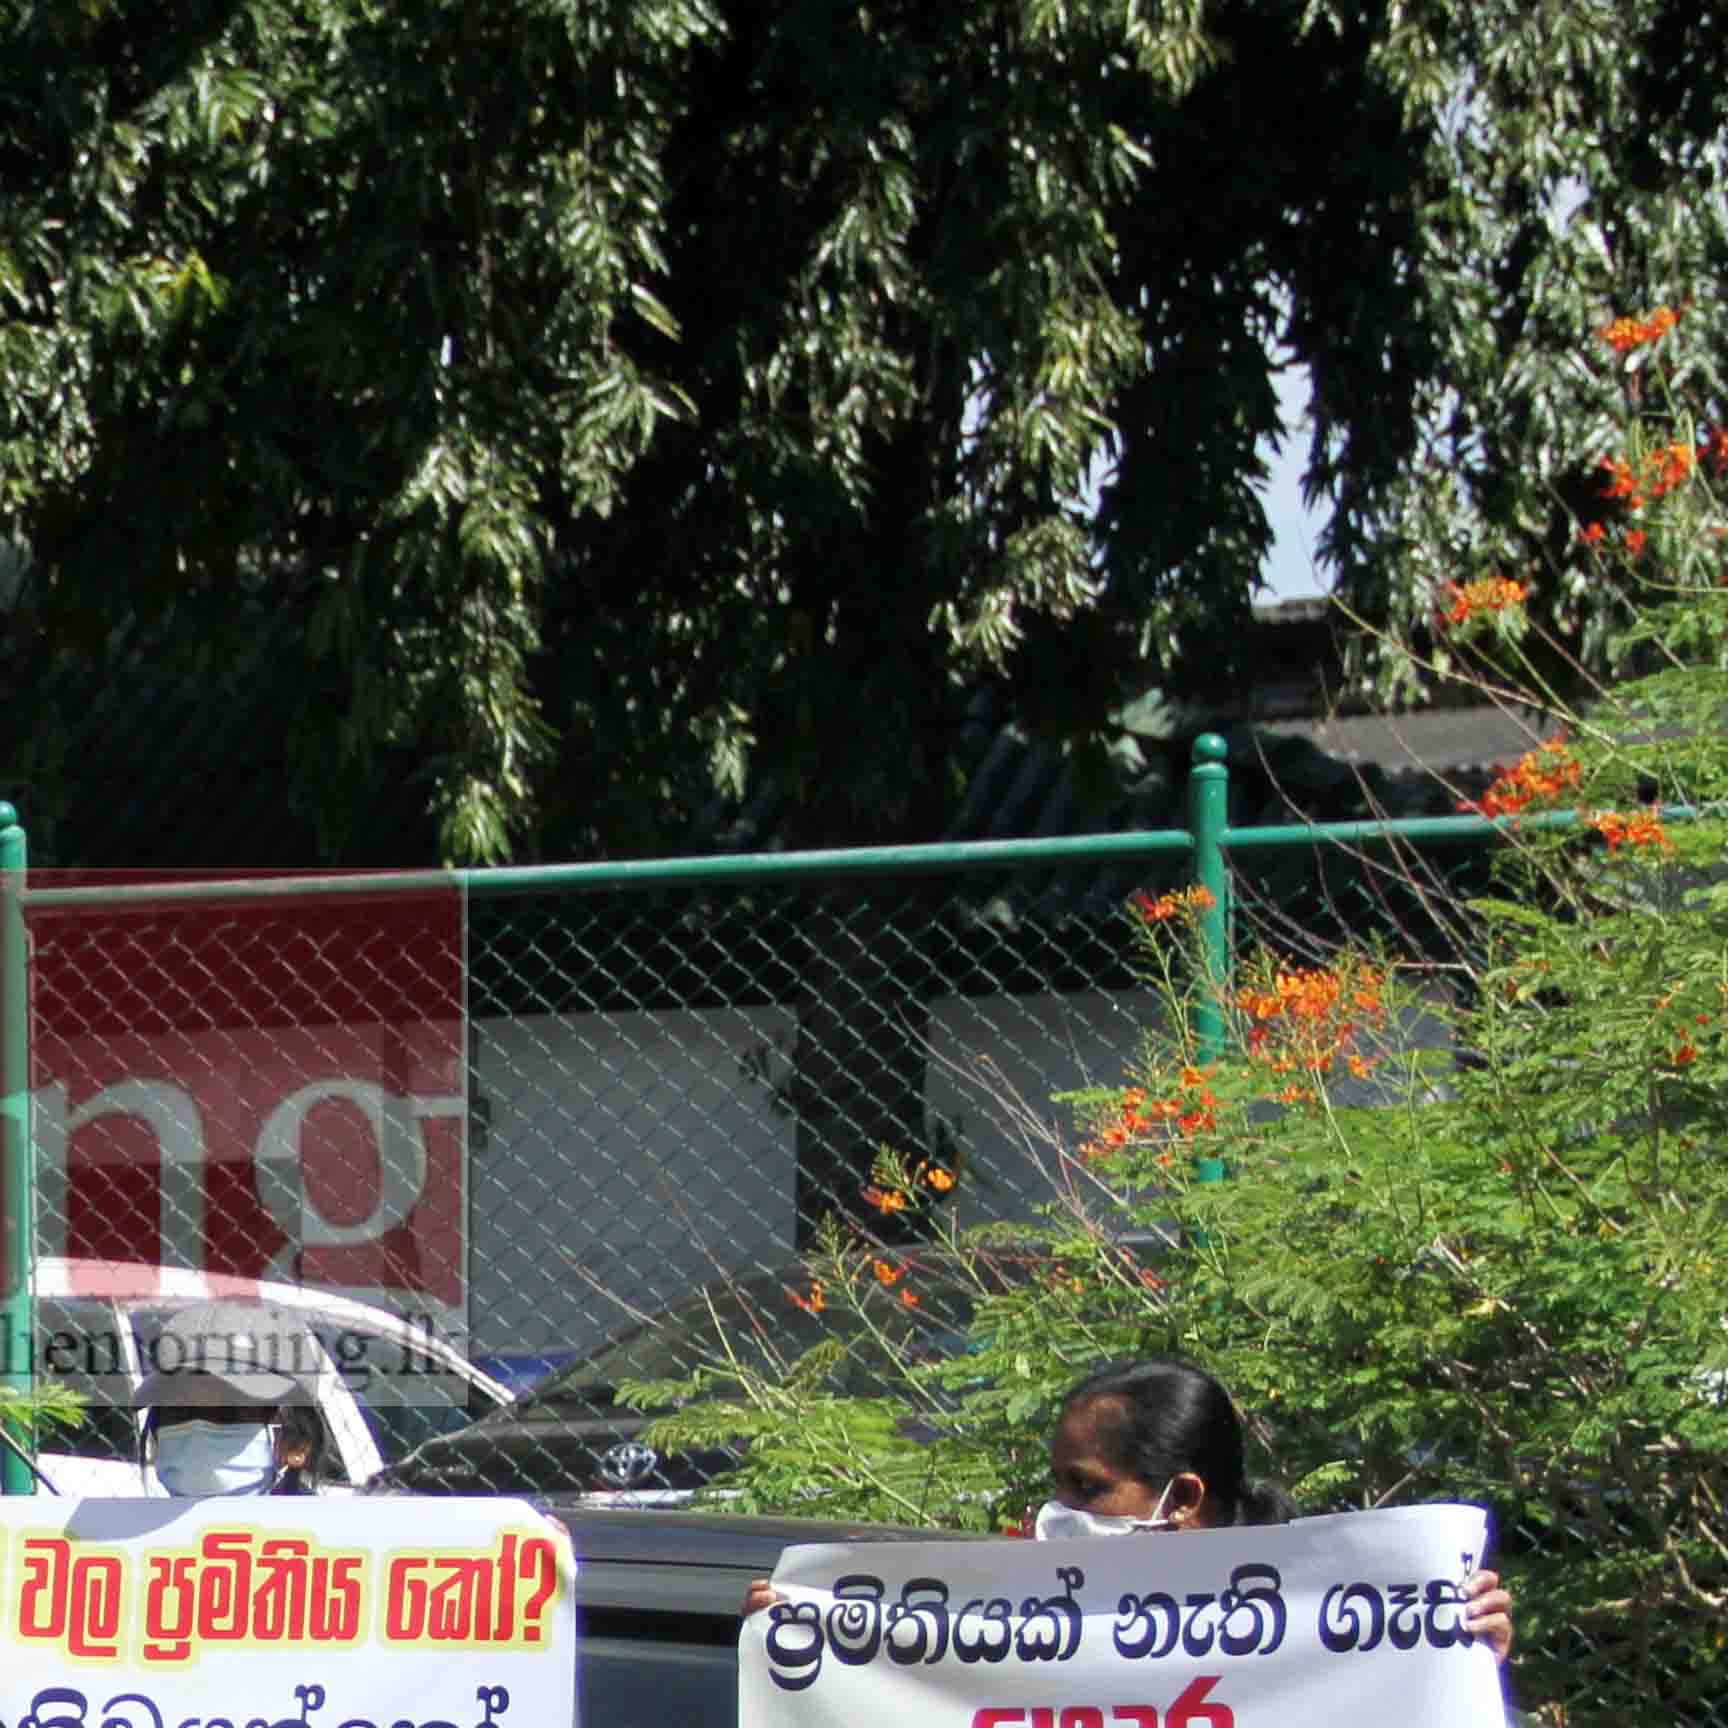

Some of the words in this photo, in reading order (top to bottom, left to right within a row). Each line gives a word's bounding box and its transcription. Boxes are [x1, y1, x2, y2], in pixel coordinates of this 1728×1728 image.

[20, 1539, 121, 1657] වල
[385, 1532, 559, 1643] කෝ?
[766, 1567, 1085, 1692] ප්‍රමිතියක්
[1113, 1563, 1287, 1661] නැති
